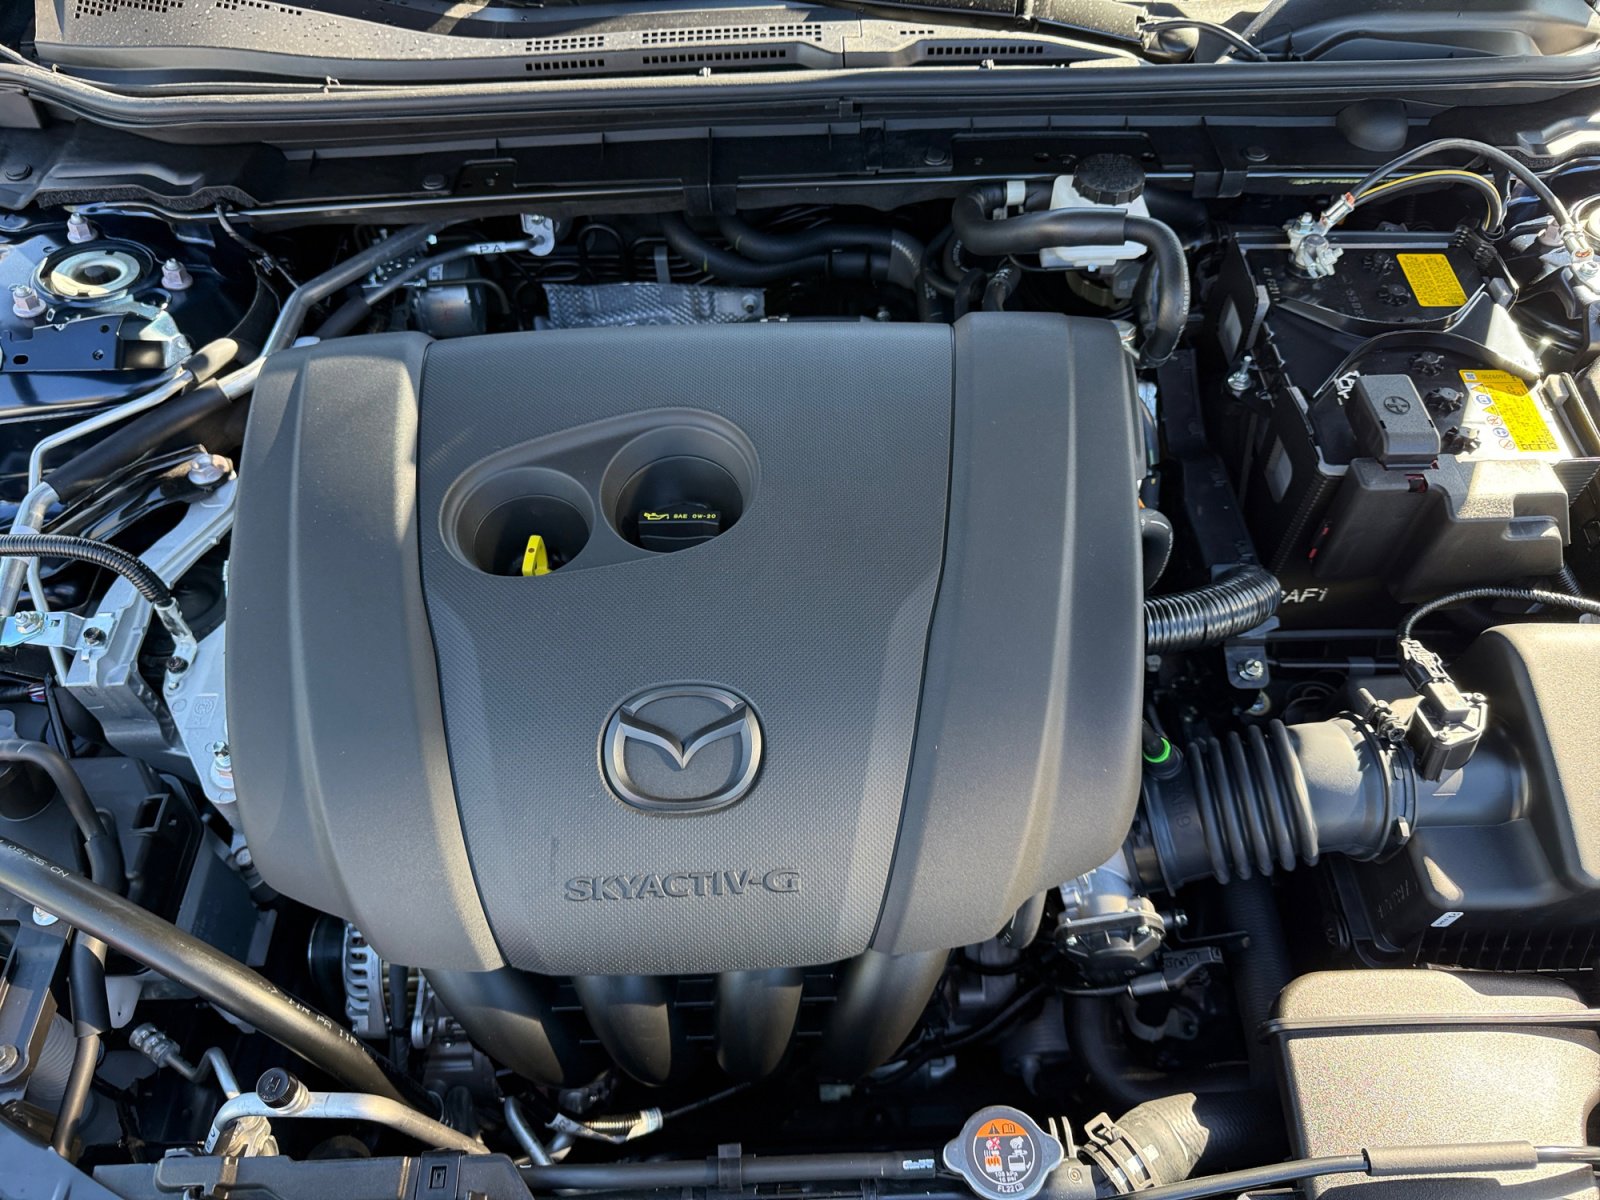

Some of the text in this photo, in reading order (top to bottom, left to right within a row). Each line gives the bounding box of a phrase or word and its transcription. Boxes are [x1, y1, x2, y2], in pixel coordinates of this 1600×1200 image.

[1280, 588, 1328, 604] AF1
[50, 866, 70, 878] CN
[564, 868, 801, 901] SKYACTIV-G
[997, 1184, 1015, 1193] FL22
